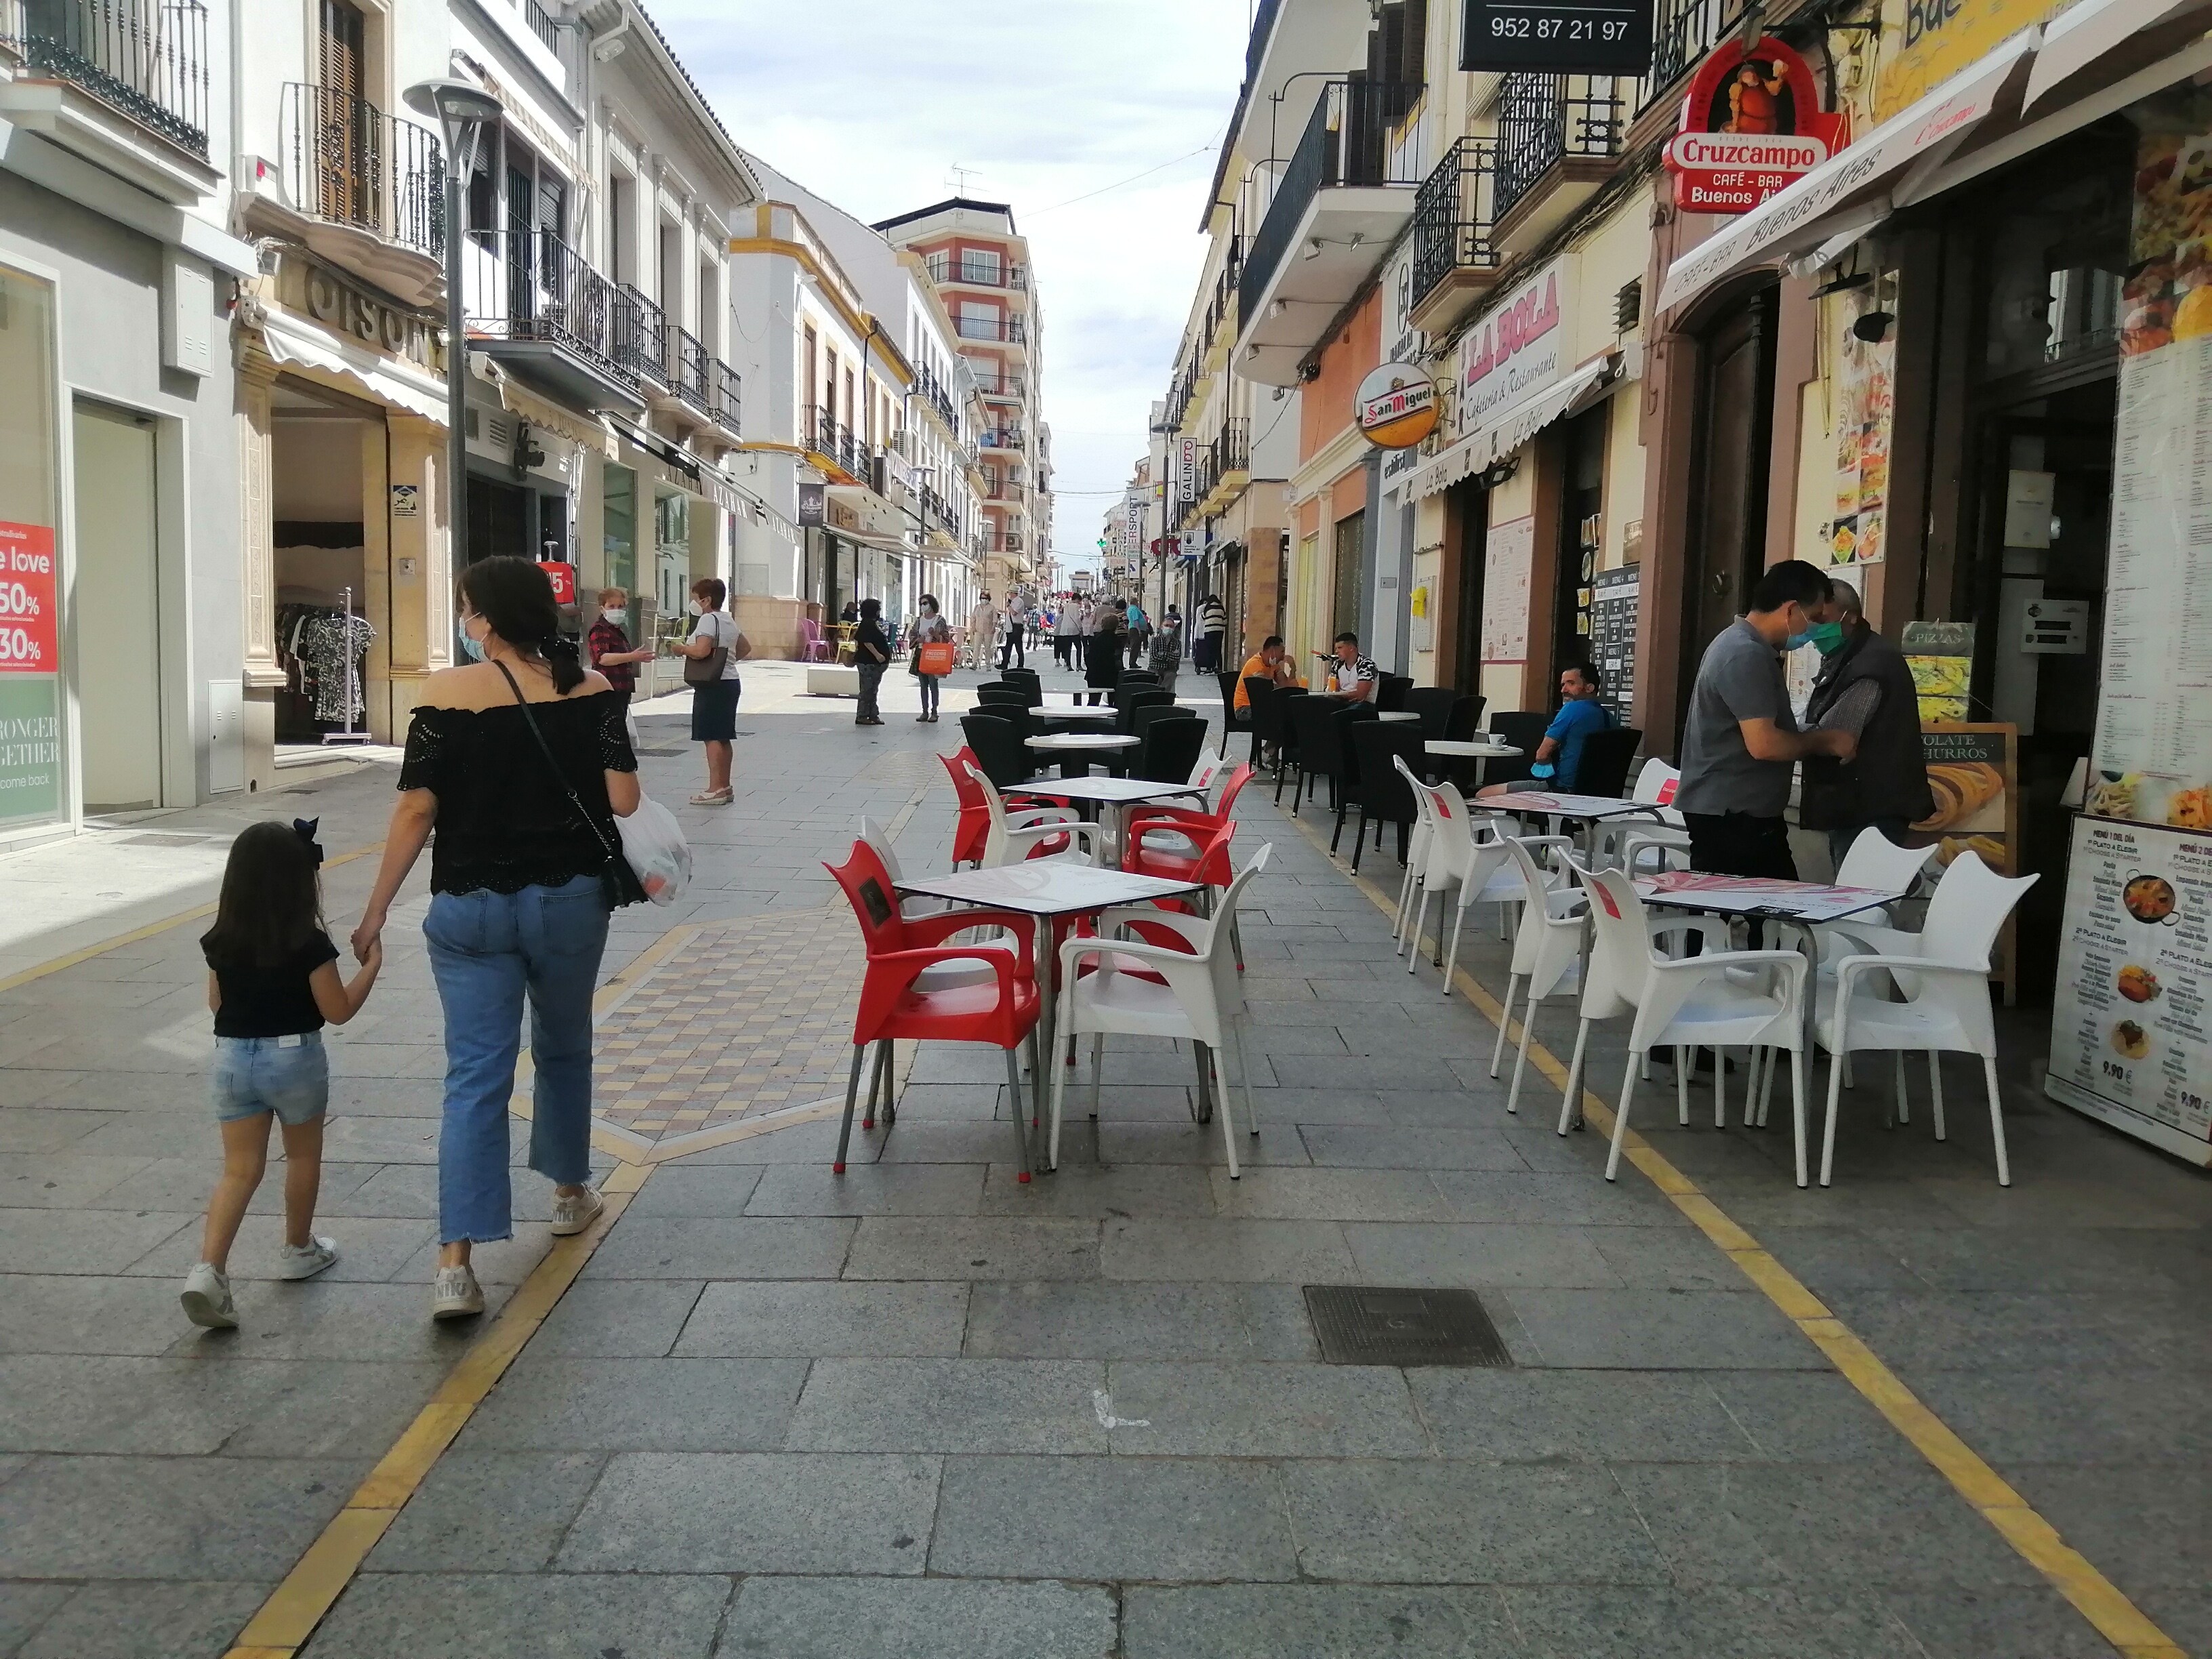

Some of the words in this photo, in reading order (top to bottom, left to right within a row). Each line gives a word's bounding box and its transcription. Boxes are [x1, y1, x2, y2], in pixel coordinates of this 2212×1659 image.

[1492, 17, 1530, 38] 952
[1537, 18, 1563, 39] 87
[1570, 20, 1593, 39] 21
[1602, 21, 1628, 41] 97
[1683, 138, 1816, 169] Cruzcampo
[1713, 172, 1745, 187] CAFÉ
[1758, 175, 1783, 188] BAR
[1692, 187, 1753, 204] Buenos
[1745, 187, 1820, 253] Buenos
[1820, 148, 1883, 205] Aires
[1467, 322, 1494, 388] LA
[1496, 270, 1559, 368] BOLA
[1508, 350, 1557, 401] Restaurante
[1182, 440, 1193, 500] GALINDO
[713, 484, 748, 519] AZAHAR
[772, 515, 796, 544] AZAHAR
[1128, 495, 1138, 562] IERSPORT
[11, 546, 50, 574] love
[1922, 735, 1975, 745] OLATE
[28, 773, 50, 787] back
[2093, 829, 2108, 840] MENÚ
[2125, 833, 2135, 844] DÍA
[2093, 840, 2111, 850] PLATO
[2179, 842, 2198, 854] MENÚ
[2179, 855, 2201, 867] PLATO
[2083, 929, 2102, 939] PLATO
[2168, 951, 2189, 963] PLATO
[2103, 1060, 2123, 1080] 9.90
[2181, 1091, 2202, 1110] 9.90
